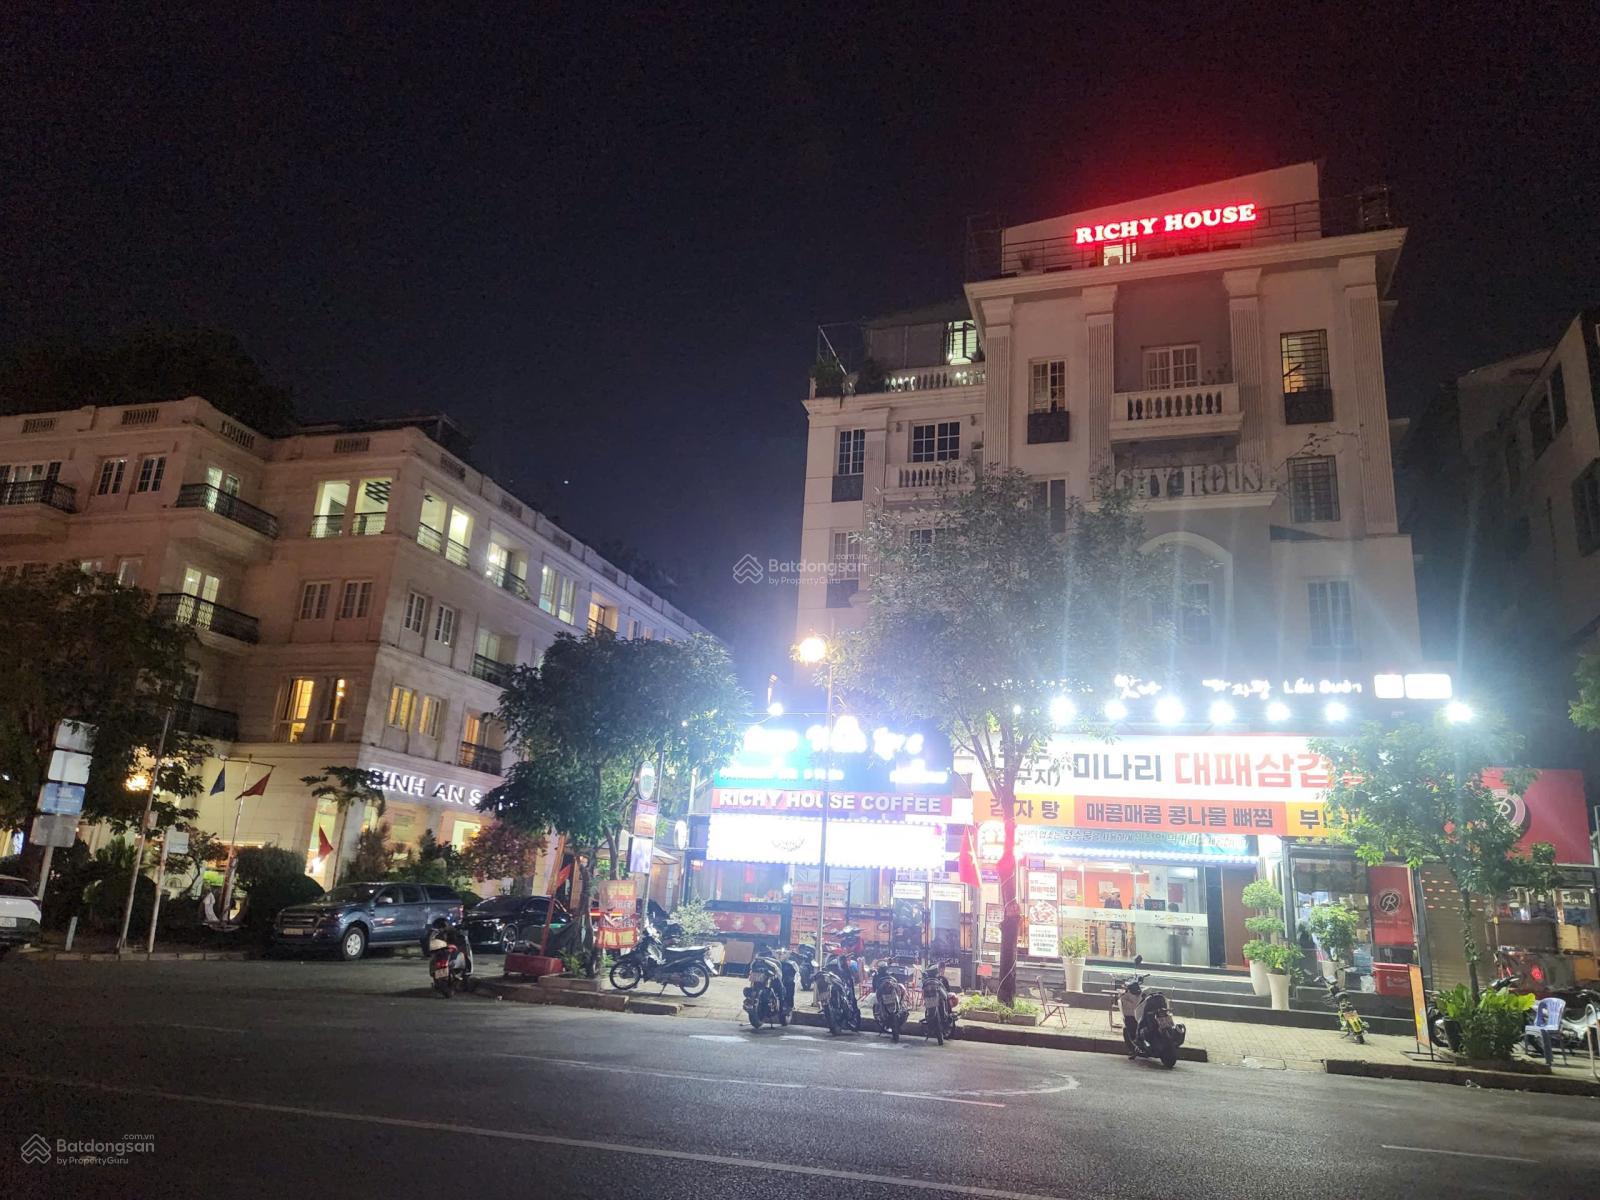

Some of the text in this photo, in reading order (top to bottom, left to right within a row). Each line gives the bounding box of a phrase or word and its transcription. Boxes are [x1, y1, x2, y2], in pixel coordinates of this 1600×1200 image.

[1076, 203, 1256, 244] RICHY HOUSE
[1073, 752, 1162, 782] 미나리
[432, 782, 466, 805] AN
[719, 789, 786, 808] RICHY
[861, 796, 941, 812] COFFEE
[1168, 805, 1227, 827] 콩나물
